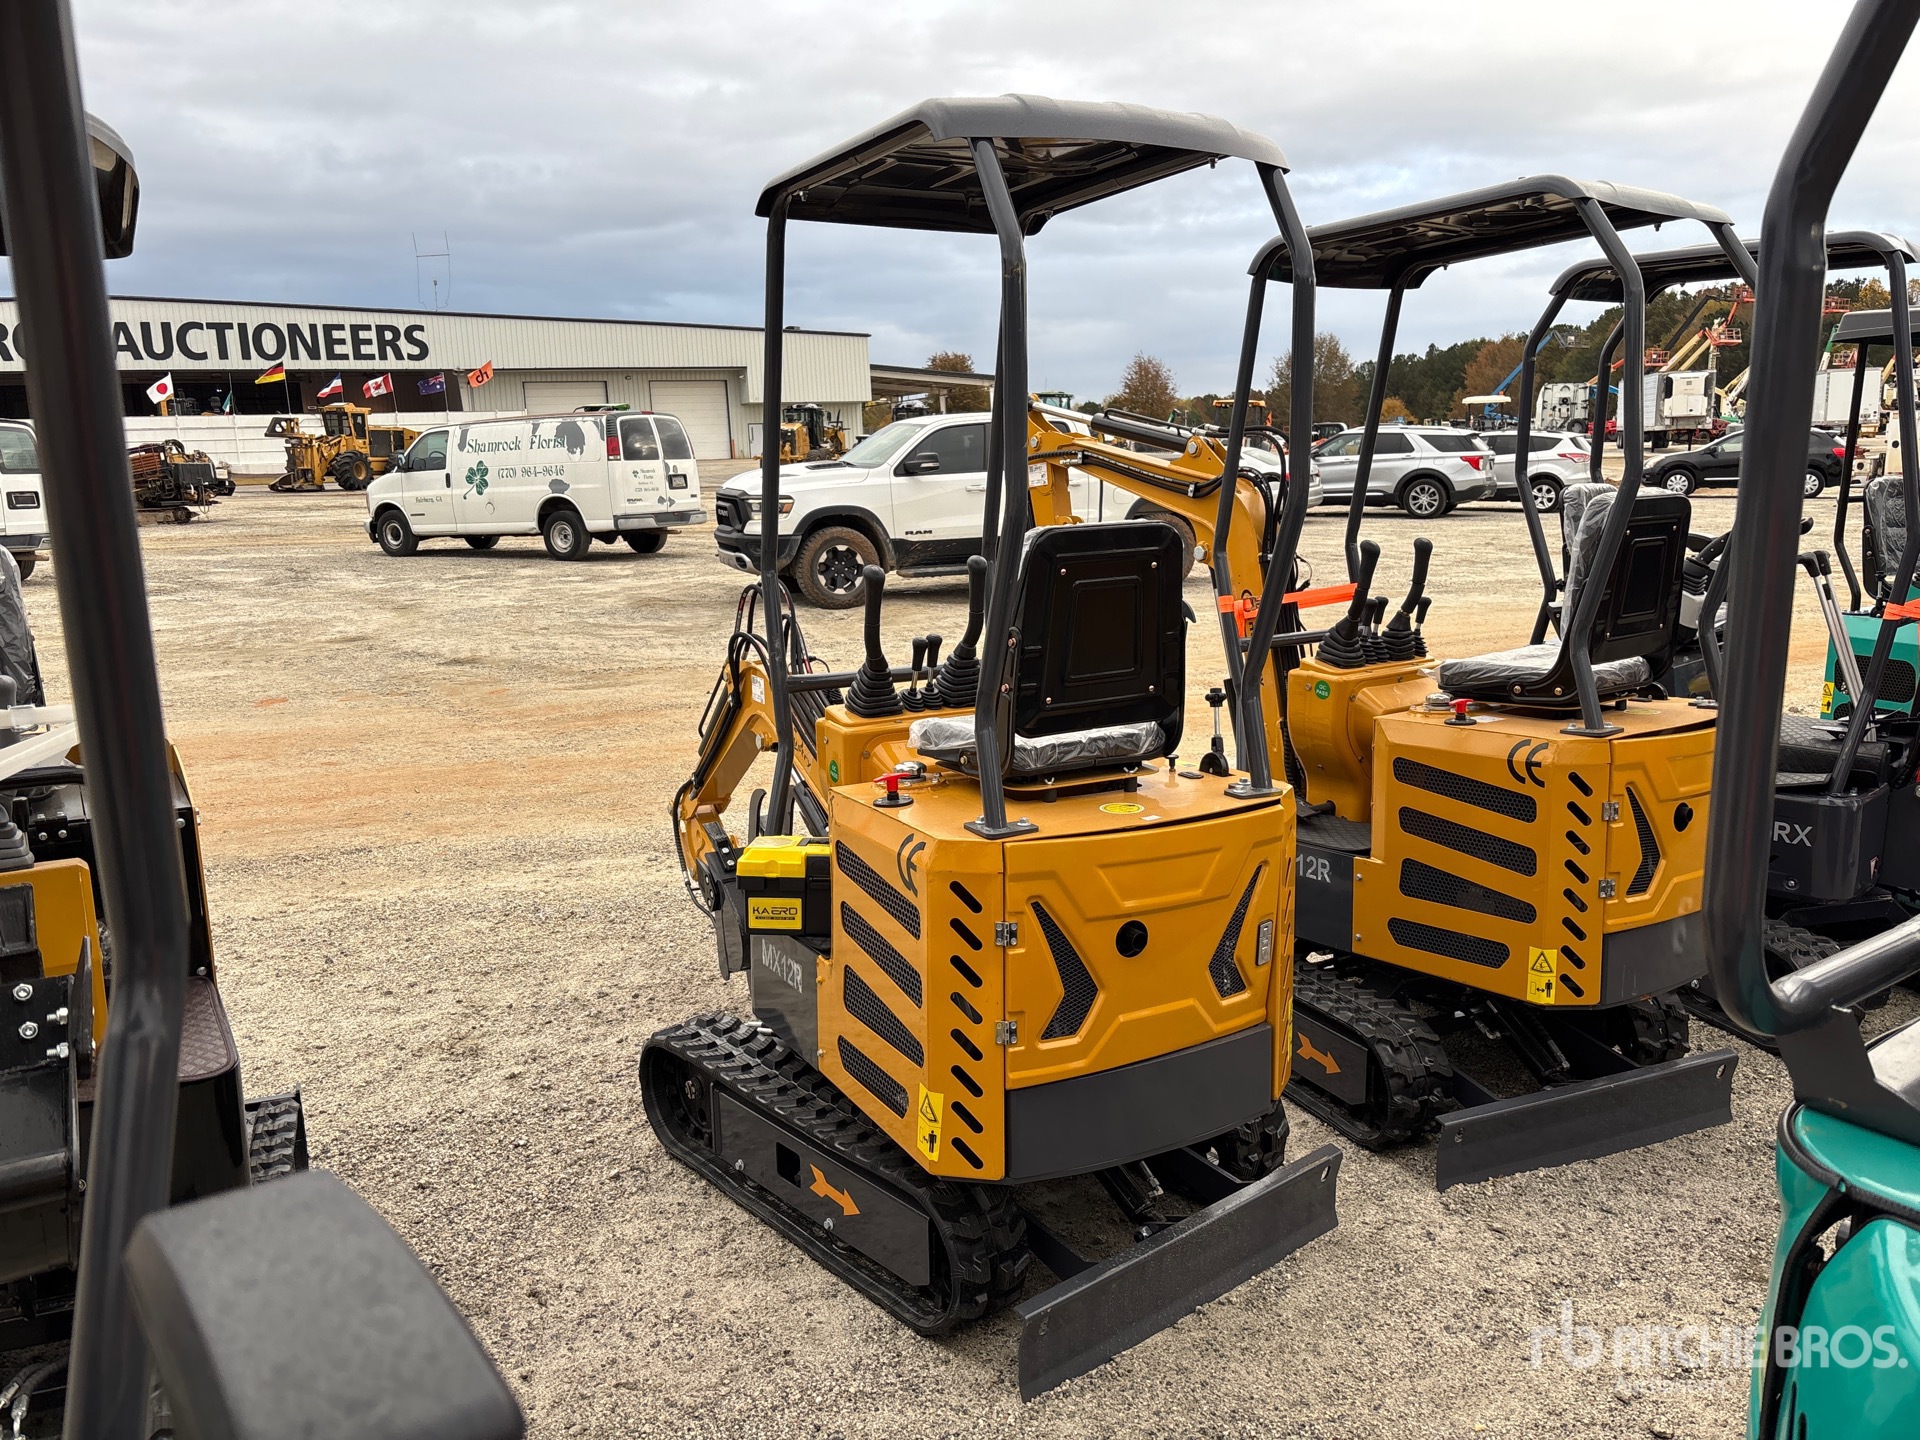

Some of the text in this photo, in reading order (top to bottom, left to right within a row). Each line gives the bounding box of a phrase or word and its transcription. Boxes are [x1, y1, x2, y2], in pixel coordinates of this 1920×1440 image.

[112, 321, 430, 362] AUCTIONEERS
[466, 434, 567, 456] Shamrock Florist
[497, 467, 517, 479] (770)
[1773, 820, 1813, 848] RX
[761, 938, 803, 994] MX12R
